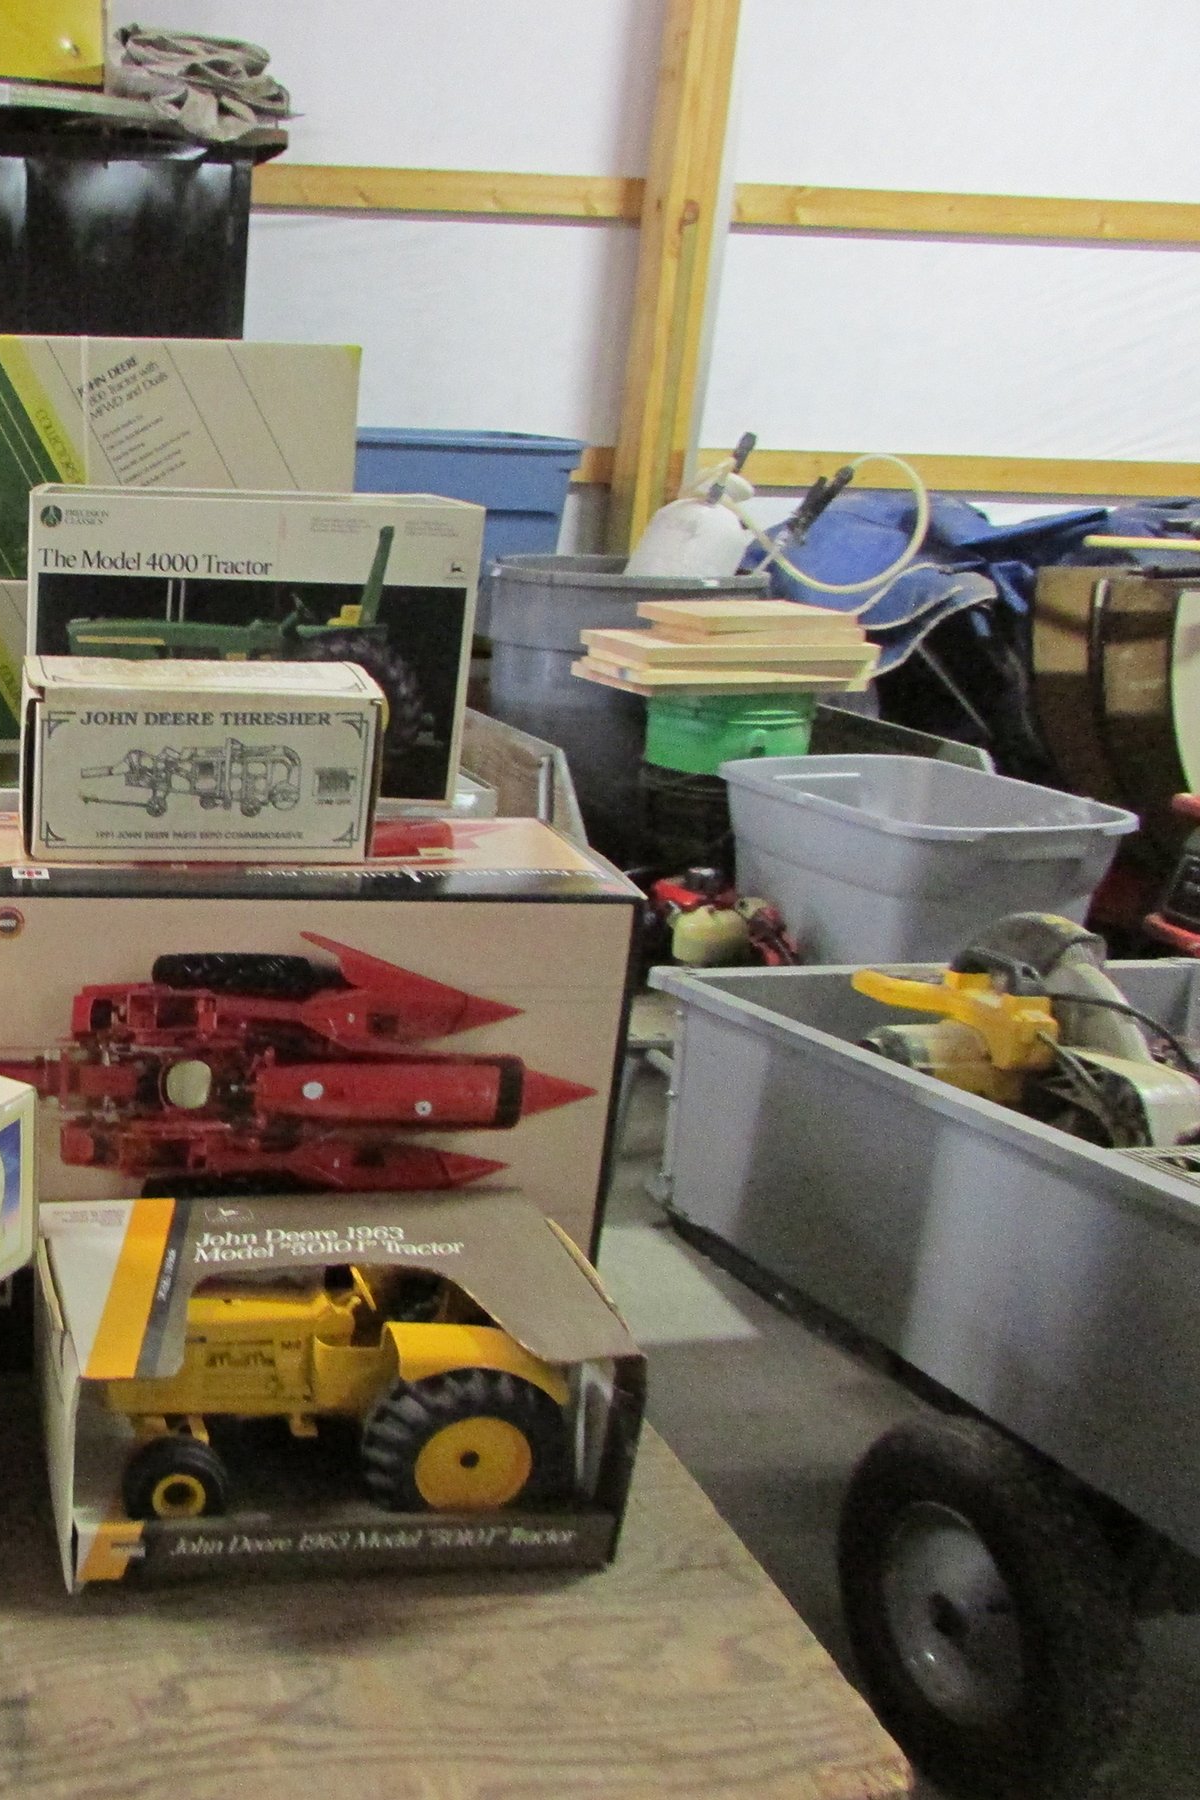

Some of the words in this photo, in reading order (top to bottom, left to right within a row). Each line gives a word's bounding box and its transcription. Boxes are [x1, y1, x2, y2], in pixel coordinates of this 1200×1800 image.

[38, 547, 78, 569] The
[81, 549, 141, 571] Model
[146, 552, 198, 573] 4000
[202, 553, 273, 576] Tractor
[80, 711, 139, 726] JOHN
[143, 711, 214, 727] DEERE
[220, 711, 332, 726] THRESHER
[195, 1230, 259, 1249] John
[264, 1227, 340, 1246] Deere
[346, 1226, 405, 1242] 1963
[192, 1240, 275, 1263] Model
[381, 1239, 466, 1258] Tractor
[170, 1536, 224, 1557] John
[227, 1536, 292, 1556] Deere
[353, 1529, 422, 1552] Model
